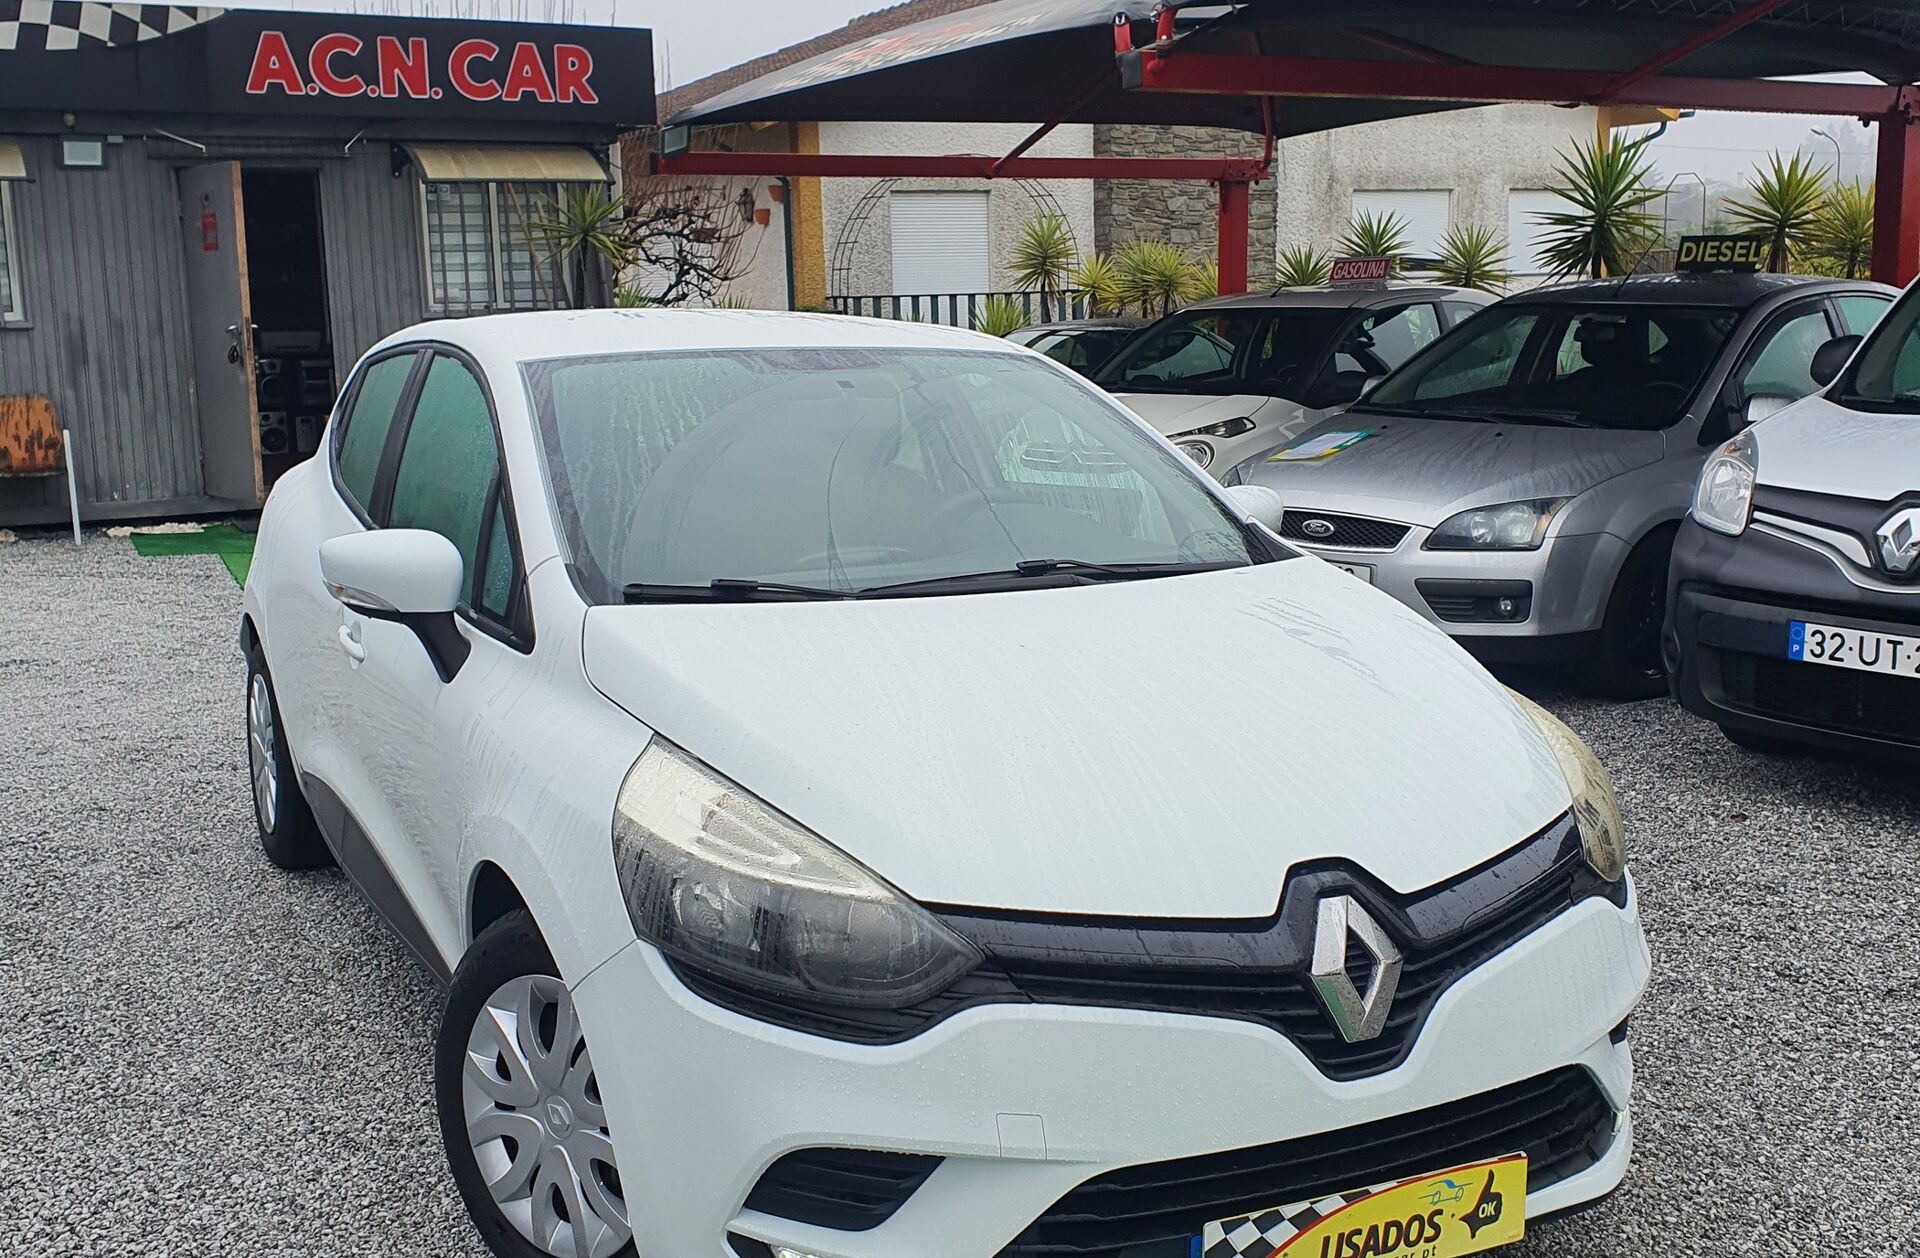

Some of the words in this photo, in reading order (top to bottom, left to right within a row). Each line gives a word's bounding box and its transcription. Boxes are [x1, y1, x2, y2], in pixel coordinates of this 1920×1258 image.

[245, 31, 443, 99] A.C.N.
[448, 39, 599, 104] CAR
[1680, 240, 1759, 262] DIESEL
[1333, 260, 1386, 280] GASOLINA
[1792, 644, 1800, 653] P
[1478, 1200, 1497, 1219] OK
[1320, 1208, 1444, 1258] USADOS
